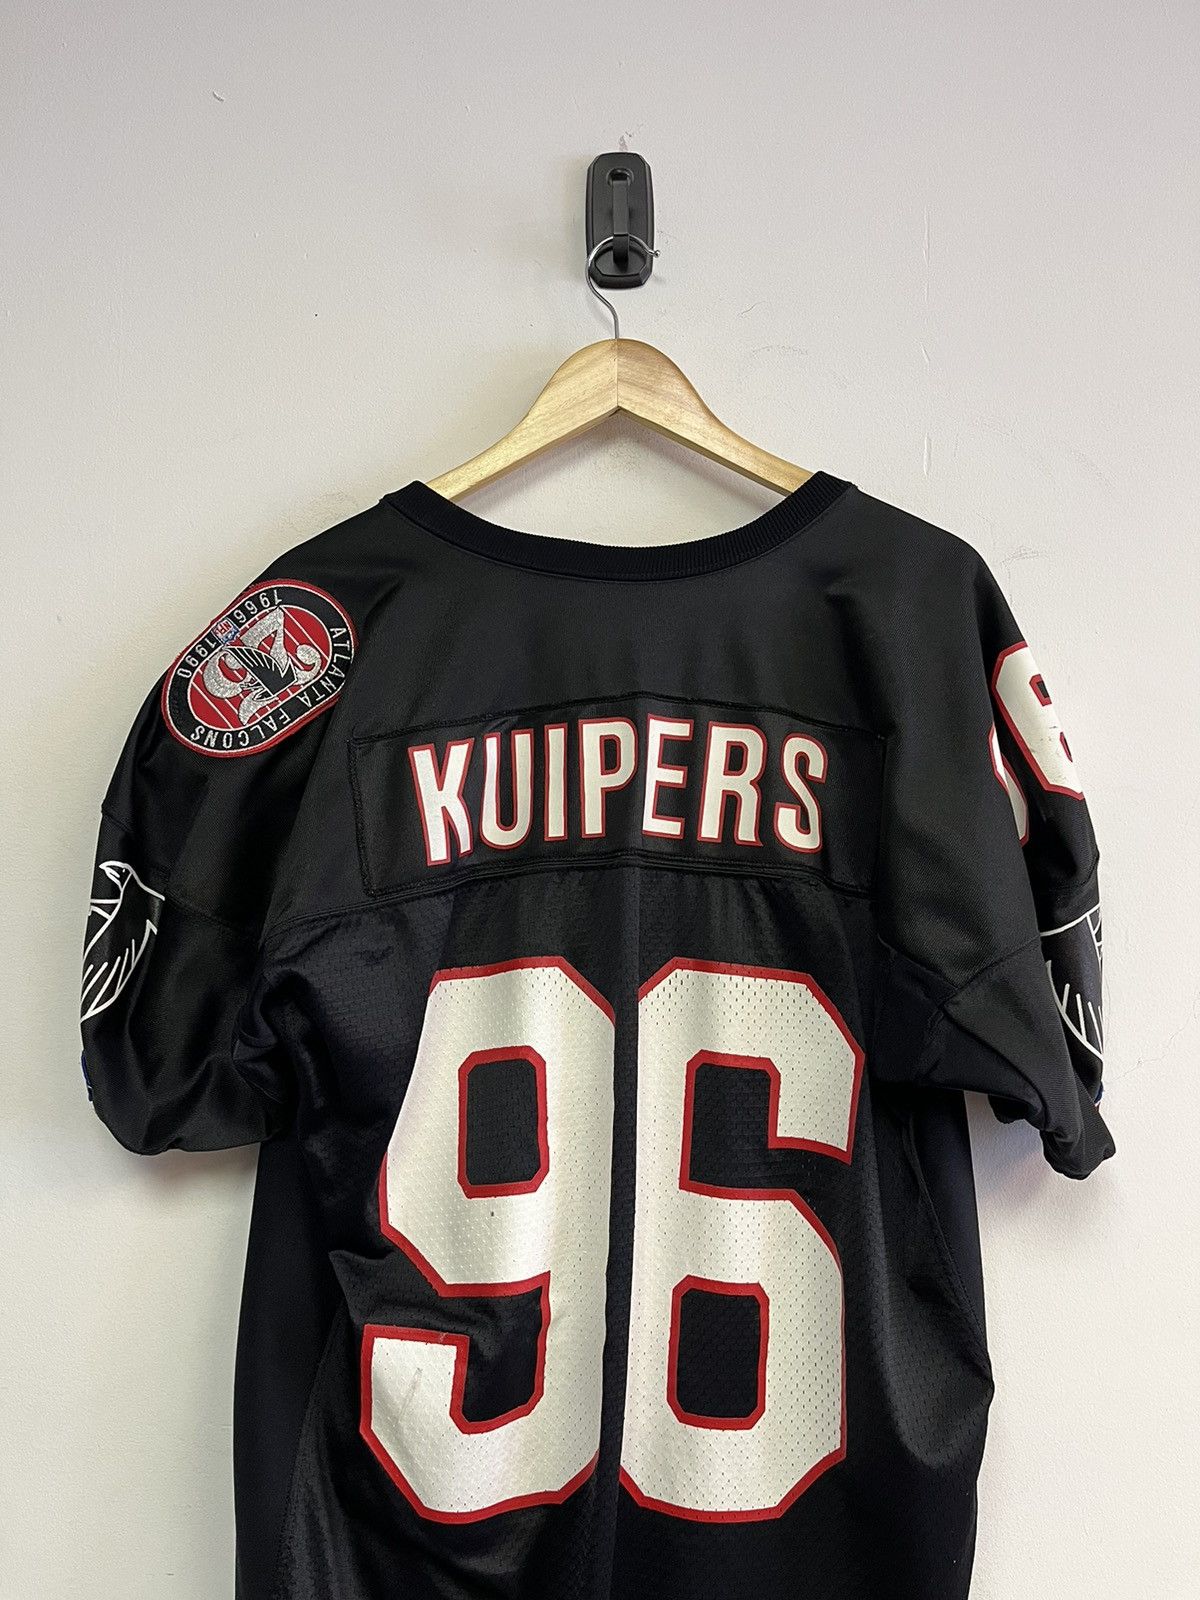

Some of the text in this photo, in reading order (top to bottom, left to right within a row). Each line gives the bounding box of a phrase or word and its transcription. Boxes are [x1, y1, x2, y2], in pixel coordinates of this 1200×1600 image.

[177, 589, 282, 679] 1966 1990
[190, 626, 351, 749] ATLANTA FALCONS
[407, 713, 829, 866] KUIPERS
[359, 956, 866, 1525] 96
